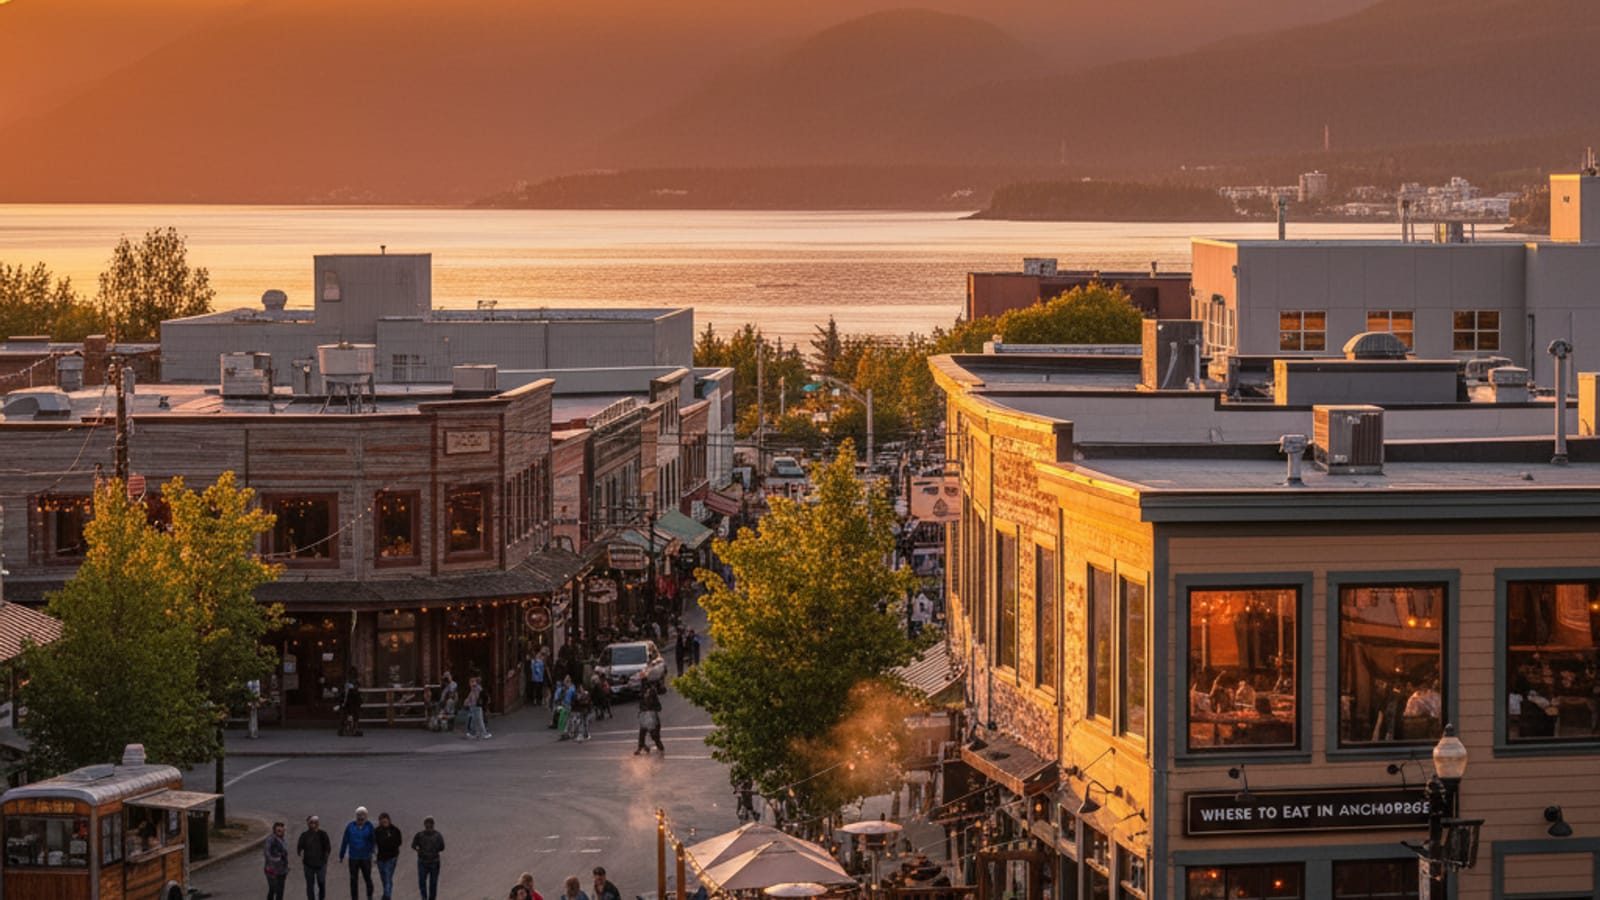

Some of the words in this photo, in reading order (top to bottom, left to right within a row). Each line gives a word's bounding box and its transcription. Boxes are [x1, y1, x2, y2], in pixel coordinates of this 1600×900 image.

[1258, 806, 1277, 819] TO
[1283, 805, 1312, 818] EAT
[1317, 804, 1333, 817] IN
